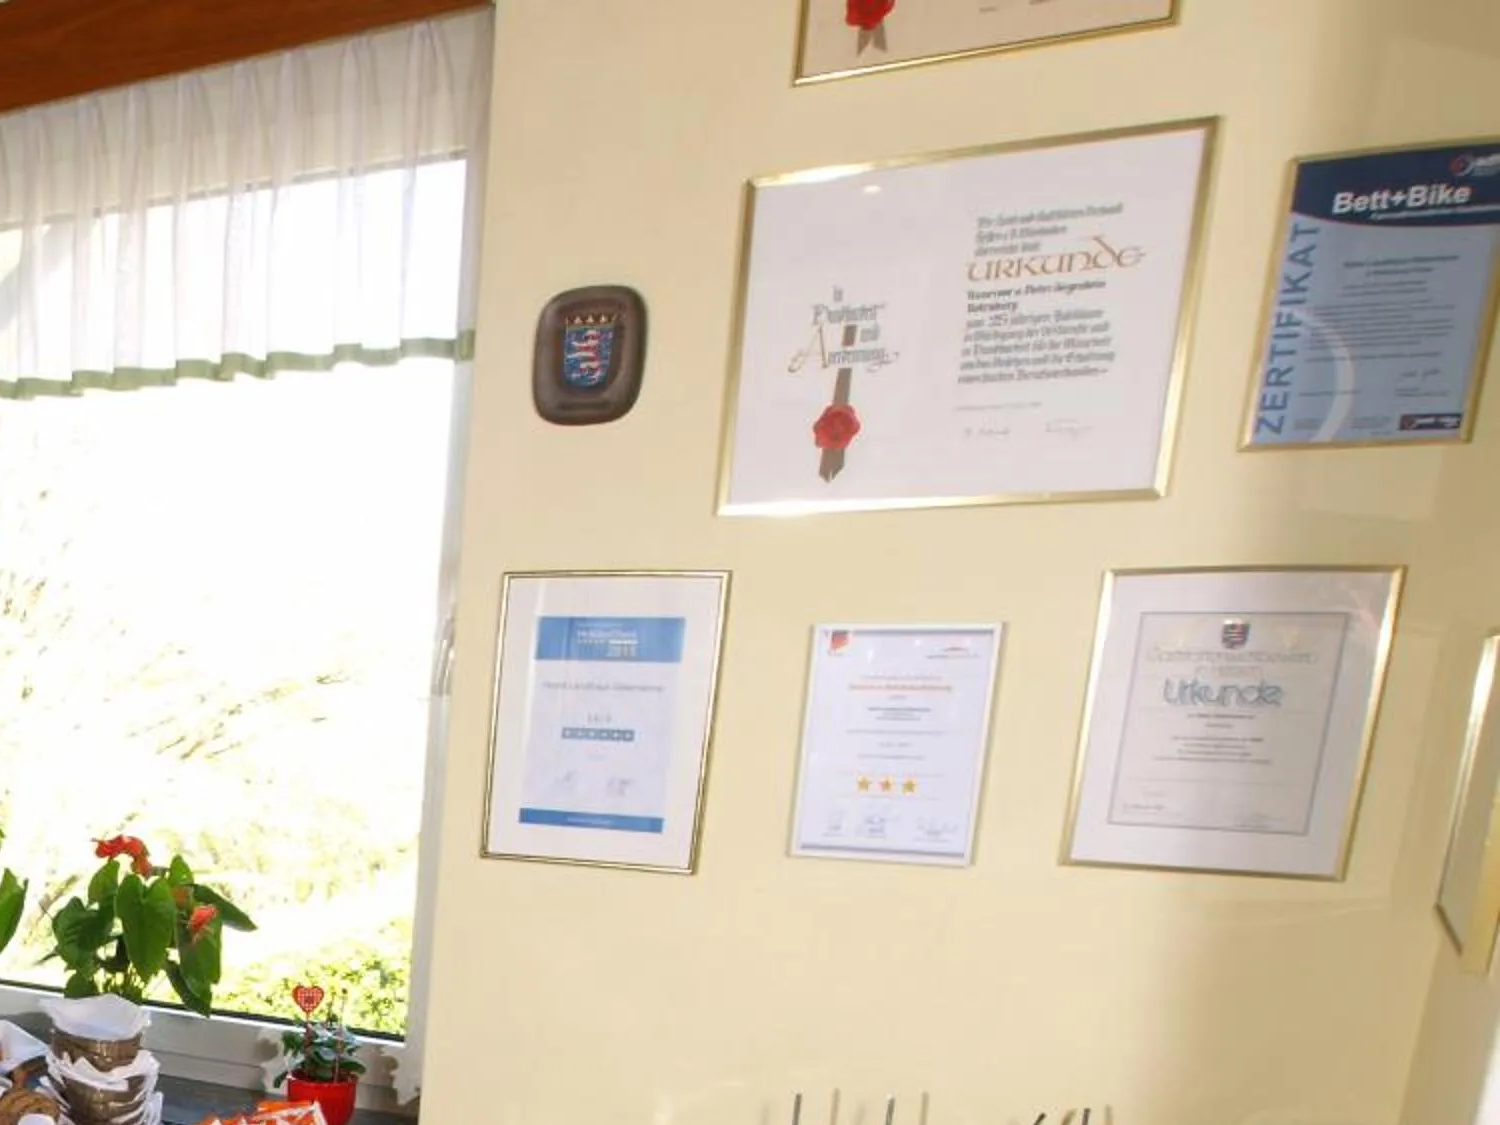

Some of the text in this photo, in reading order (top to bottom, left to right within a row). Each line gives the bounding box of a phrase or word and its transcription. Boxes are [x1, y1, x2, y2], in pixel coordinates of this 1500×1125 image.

[1332, 183, 1475, 215] Bett+Bike
[1255, 224, 1320, 434] ZERTIFIKAT
[1162, 677, 1284, 708] Urkunde
